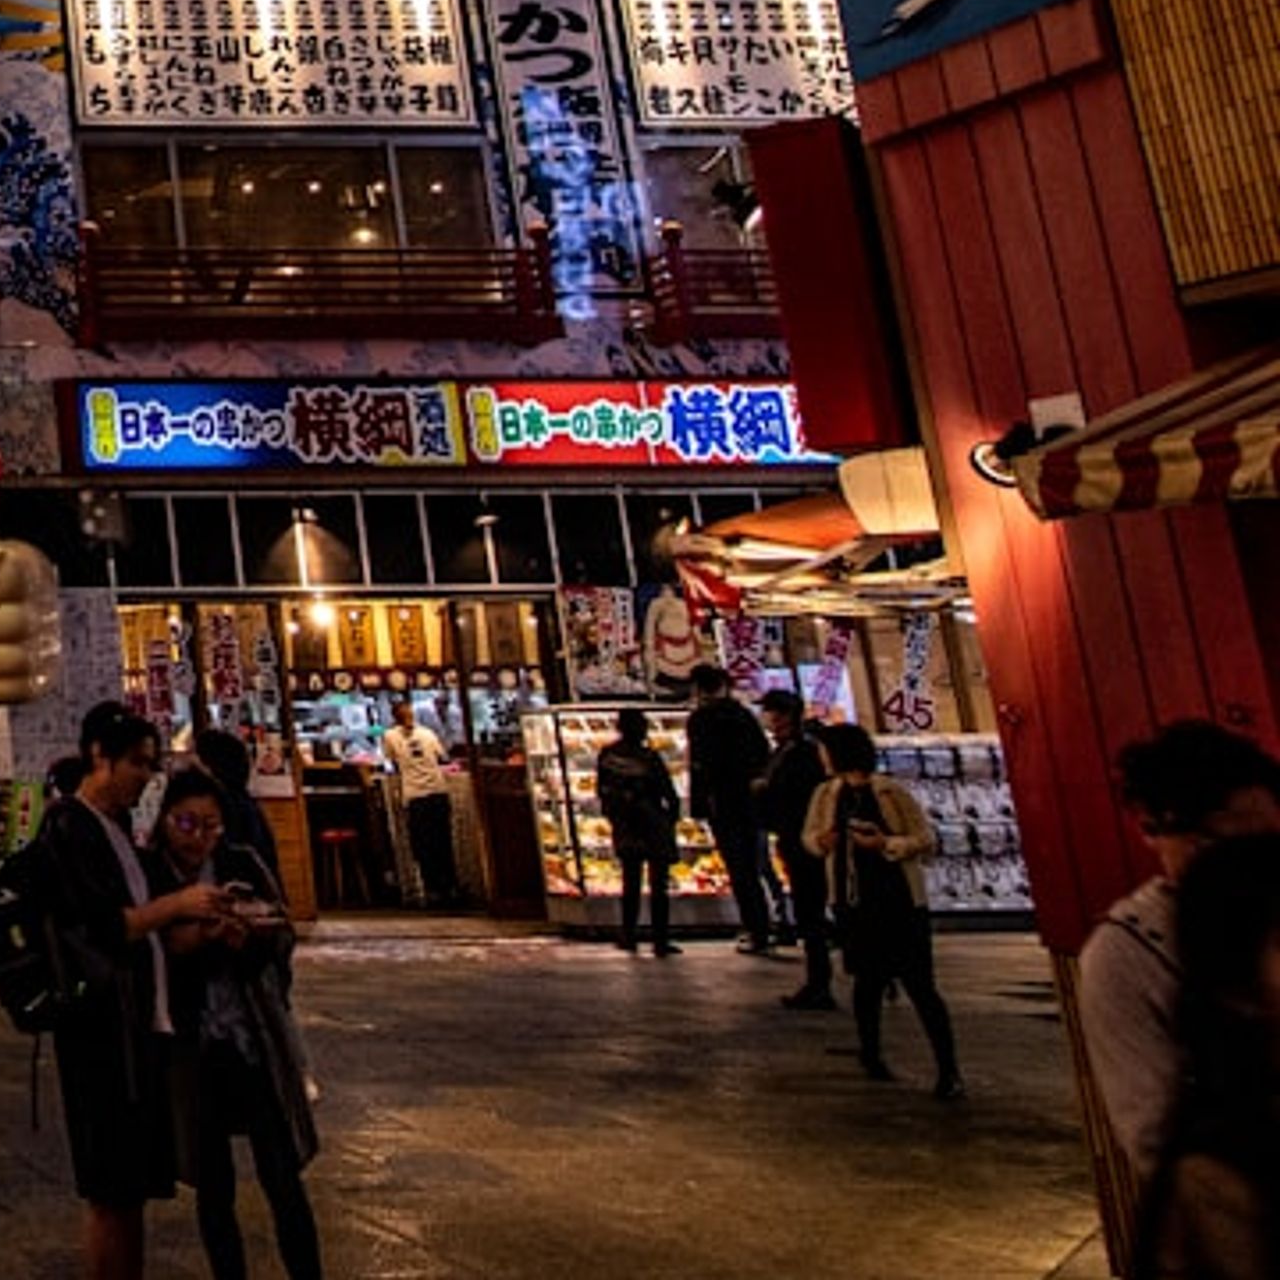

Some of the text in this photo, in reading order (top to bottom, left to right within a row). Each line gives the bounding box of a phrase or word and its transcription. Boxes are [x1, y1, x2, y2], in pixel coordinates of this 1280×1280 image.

[120, 404, 287, 446] 日本一の串かつ
[289, 389, 415, 459] 横綱
[499, 404, 663, 446] 日本一の串かつ
[666, 388, 791, 456] 横綱
